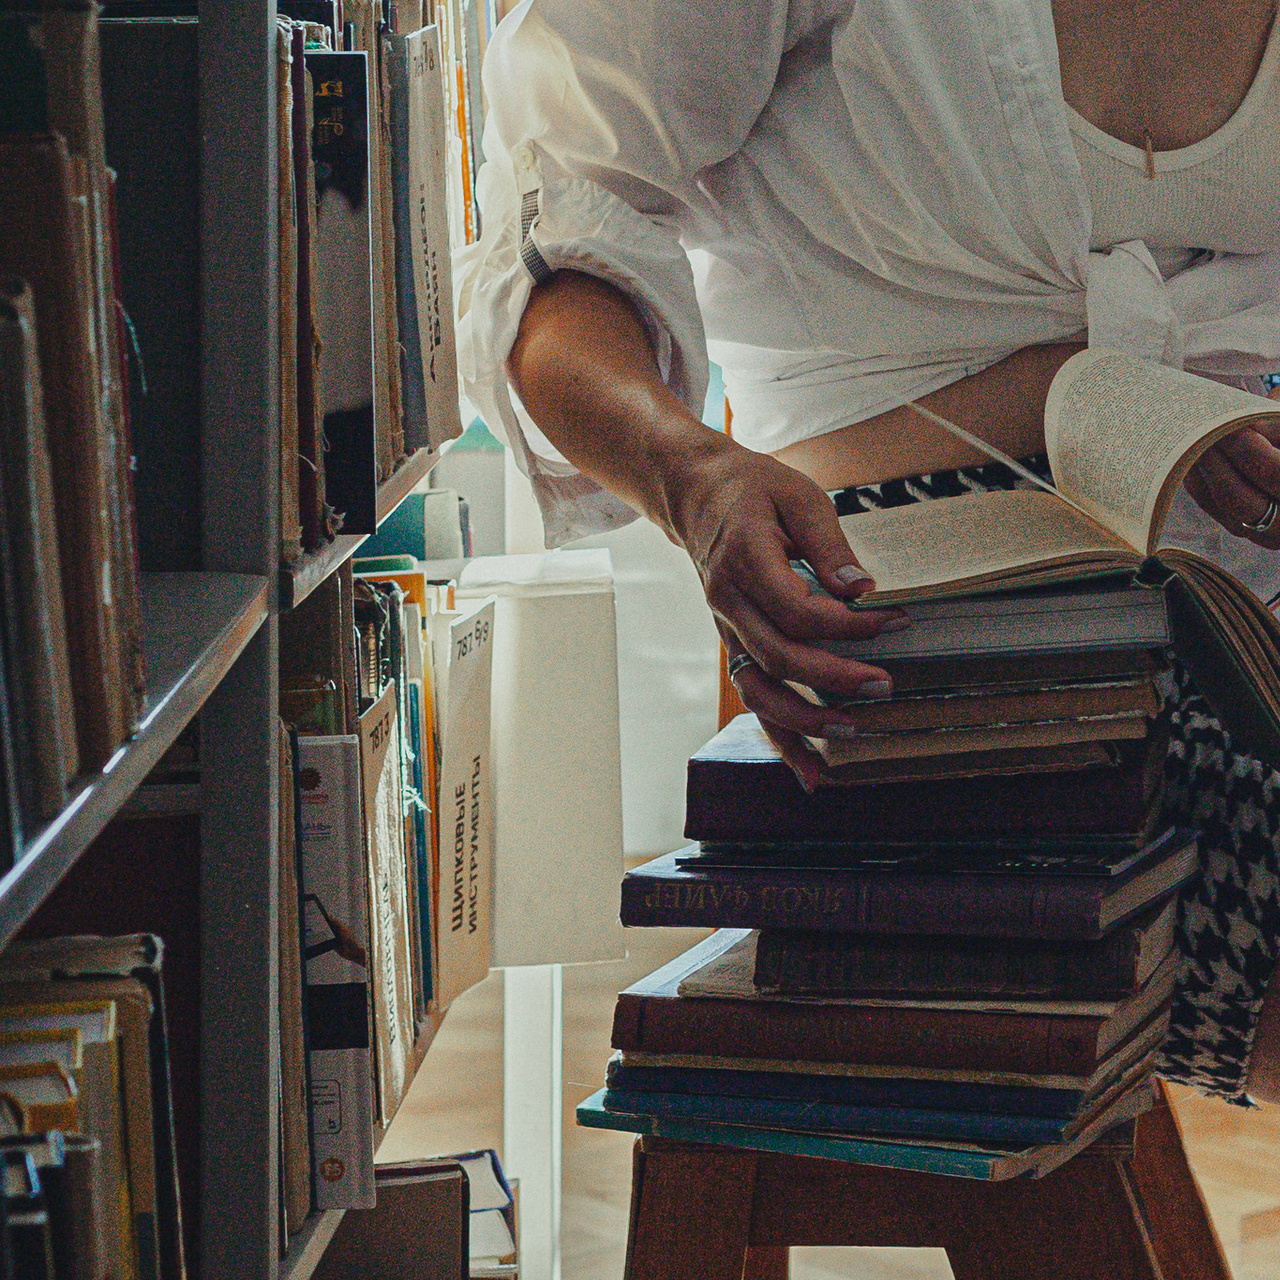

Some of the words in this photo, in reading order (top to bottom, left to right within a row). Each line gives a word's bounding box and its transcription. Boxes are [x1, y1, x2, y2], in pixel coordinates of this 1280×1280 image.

[451, 779, 467, 934] ЩИПКОВЫЕ
[467, 753, 481, 936] ИНСТРУМЕНТЫ
[645, 883, 749, 911] ФЛИЕР
[760, 887, 842, 915] ЯКОВ
